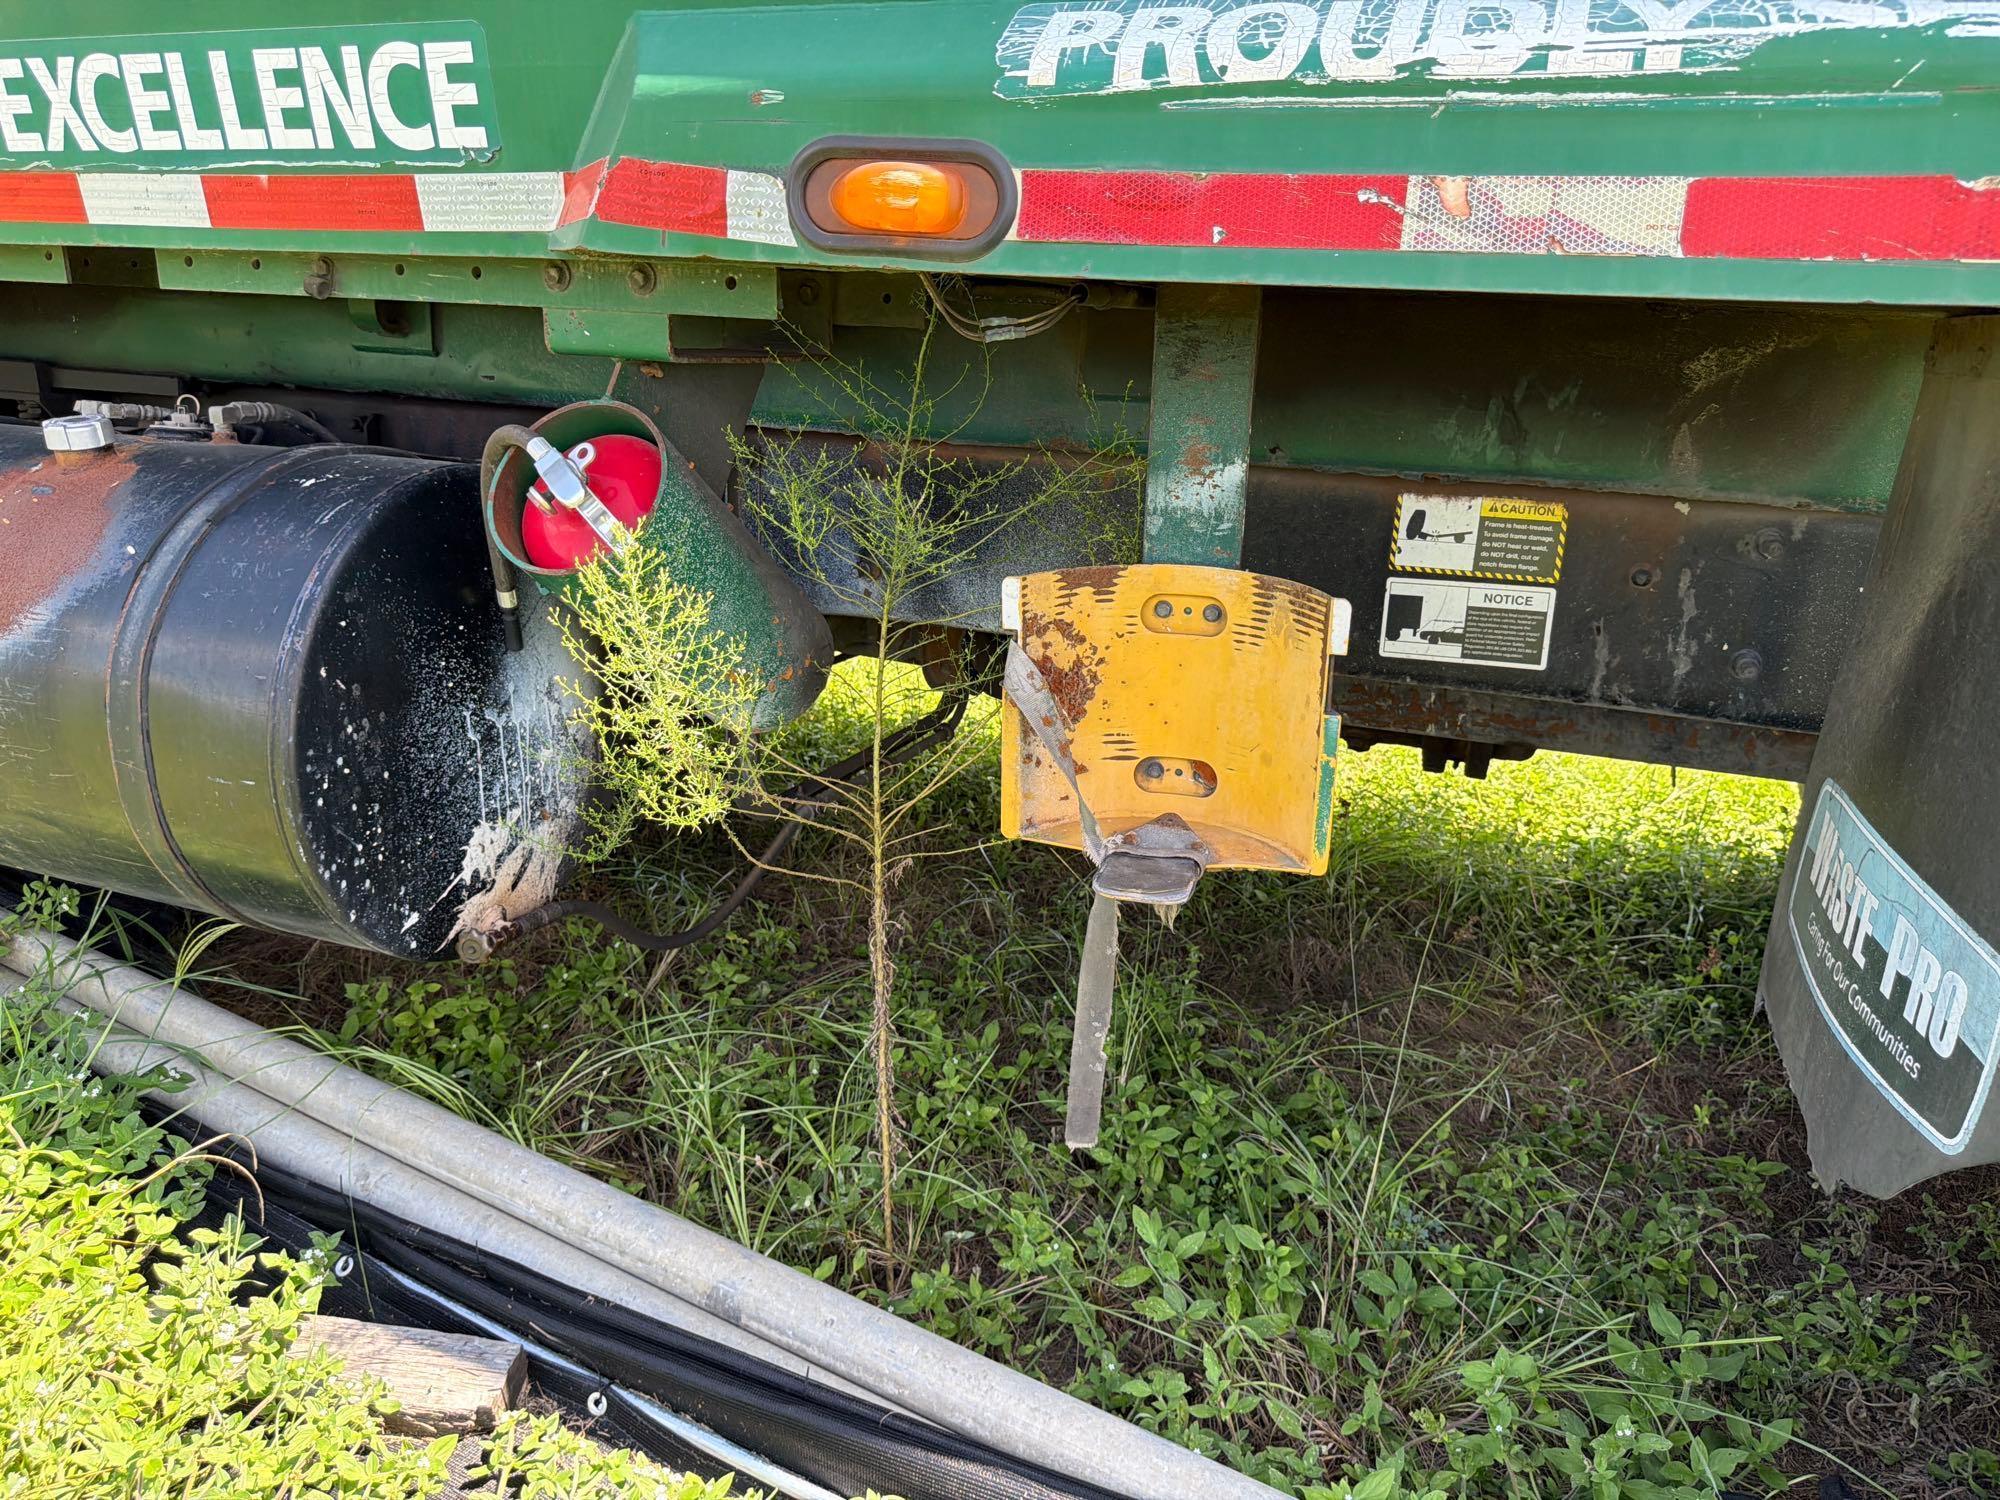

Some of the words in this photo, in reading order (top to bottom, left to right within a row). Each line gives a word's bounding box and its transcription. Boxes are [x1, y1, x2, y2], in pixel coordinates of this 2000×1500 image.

[1026, 0, 1712, 87] PROUDLY
[0, 41, 489, 153] EXCELLENCE
[1501, 503, 1555, 516] CAUTION
[1512, 523, 1554, 531] heat-treated.
[1498, 561, 1516, 569] frame
[1484, 593, 1534, 606] NOTICE
[1809, 810, 1879, 970] WASTE
[1879, 911, 1968, 1059] PRO
[1807, 911, 1826, 959] Caring
[1823, 942, 1836, 974] For
[1833, 963, 1850, 991] Our
[1847, 983, 1921, 1080] Communities
